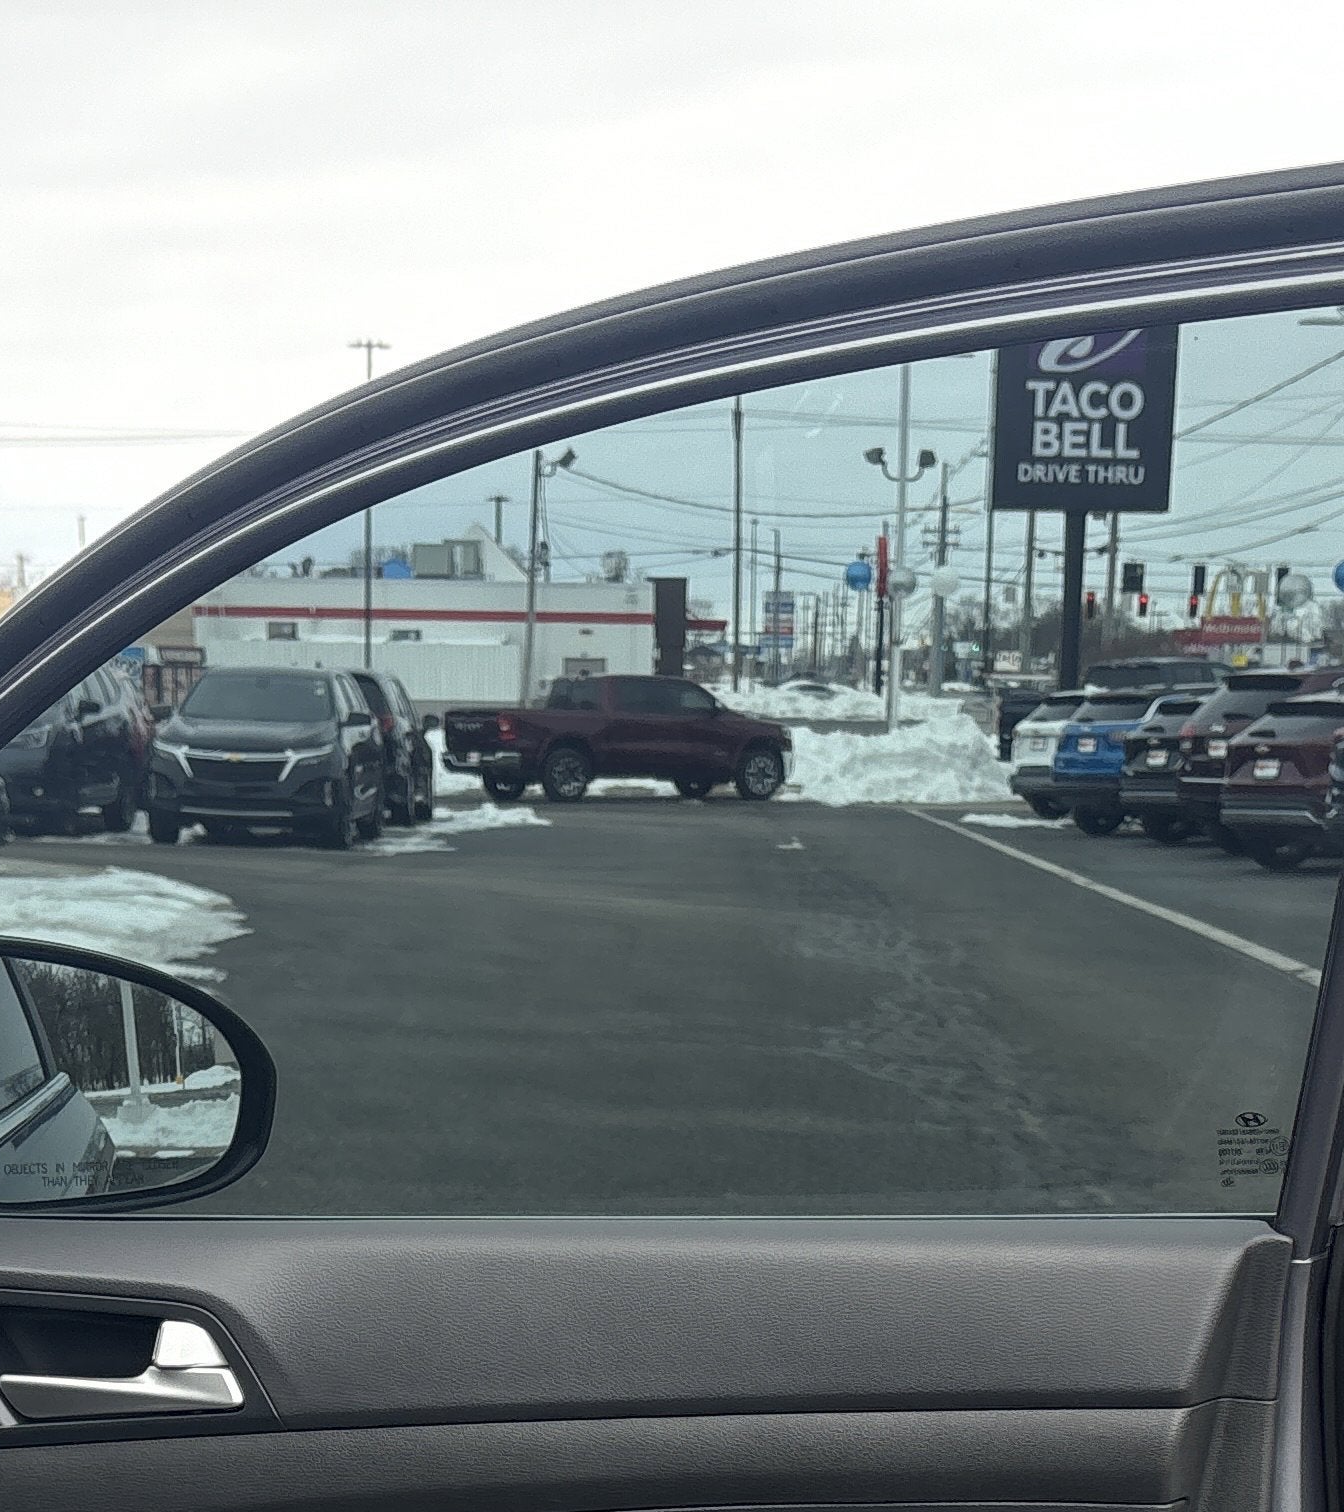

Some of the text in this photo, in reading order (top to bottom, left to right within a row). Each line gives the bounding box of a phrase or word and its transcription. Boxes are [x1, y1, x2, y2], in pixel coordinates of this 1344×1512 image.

[1025, 380, 1145, 421] TACO
[1032, 420, 1140, 459] BELL
[1017, 462, 1145, 485] DRIVE THRU
[3, 1162, 48, 1175] OBJECTS
[55, 1162, 65, 1173] IN
[42, 1176, 68, 1187] THAN
